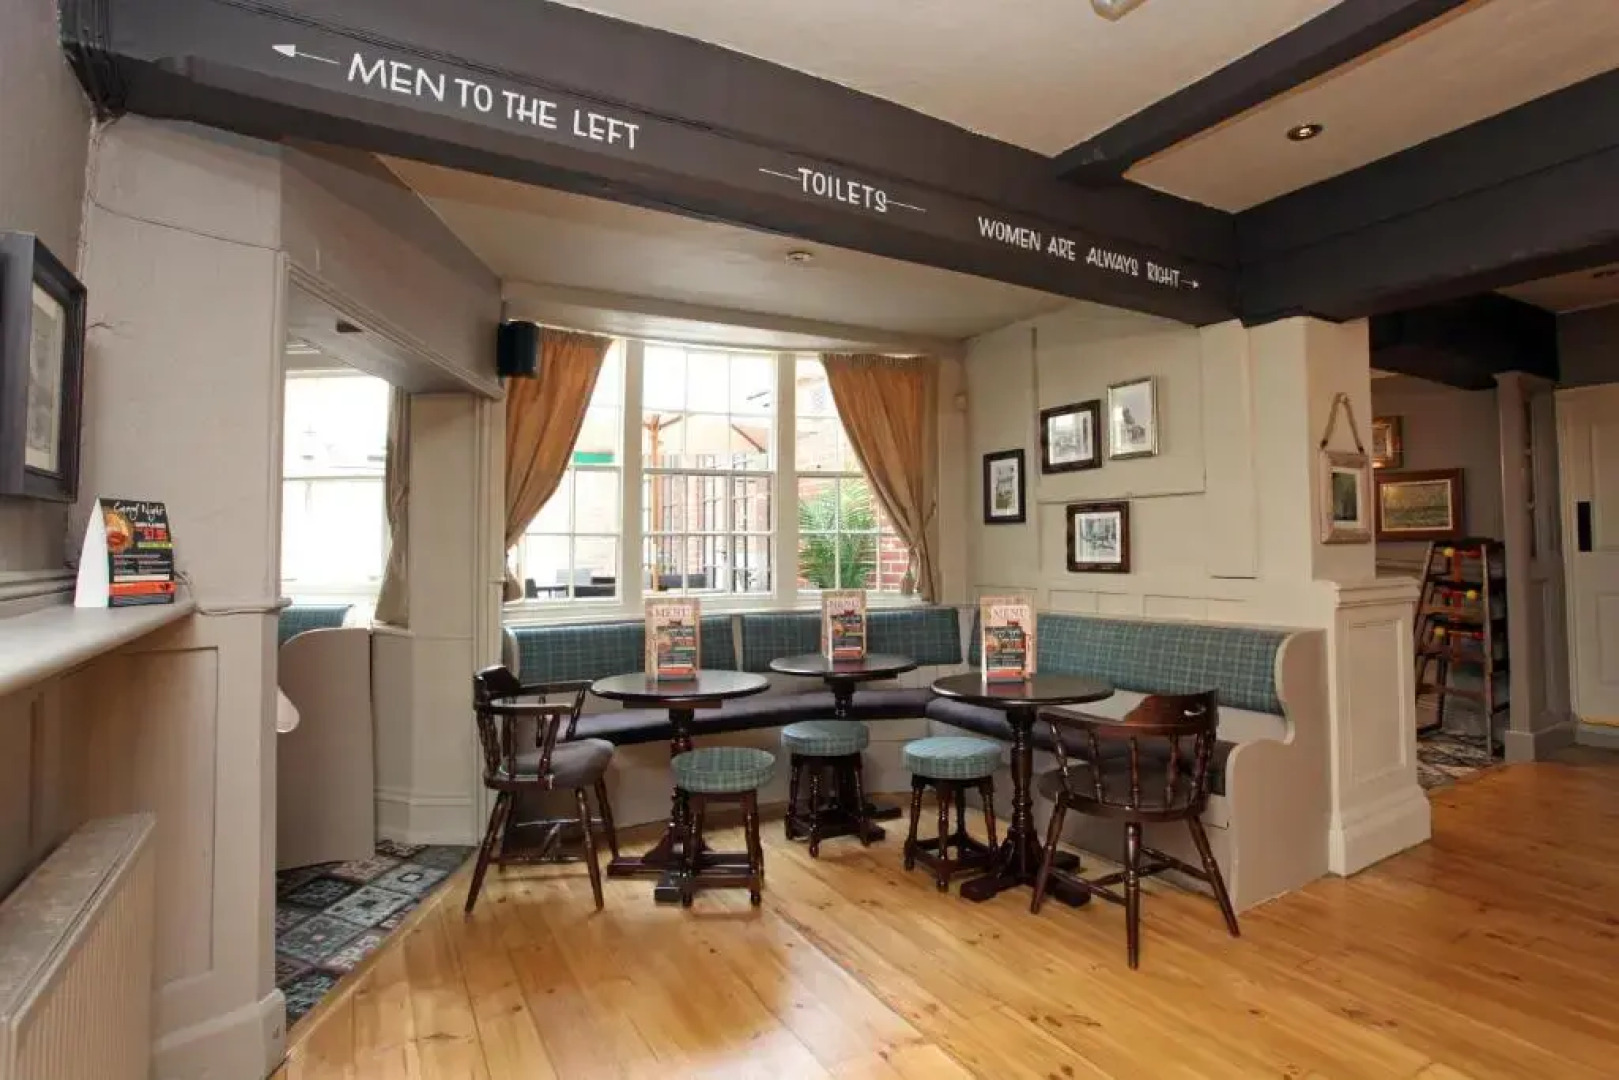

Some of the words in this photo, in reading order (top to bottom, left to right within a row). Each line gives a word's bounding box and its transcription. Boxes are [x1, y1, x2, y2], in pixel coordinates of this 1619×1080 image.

[347, 52, 446, 102] MEN
[453, 78, 493, 113] TO
[501, 89, 558, 130] THE
[573, 108, 640, 150] LEFT
[798, 167, 887, 213] TOILETS
[978, 216, 1041, 251] WOMEN
[1047, 236, 1076, 262] ARE
[1086, 246, 1138, 277] ALWAYS
[1147, 261, 1180, 288] RIGHT
